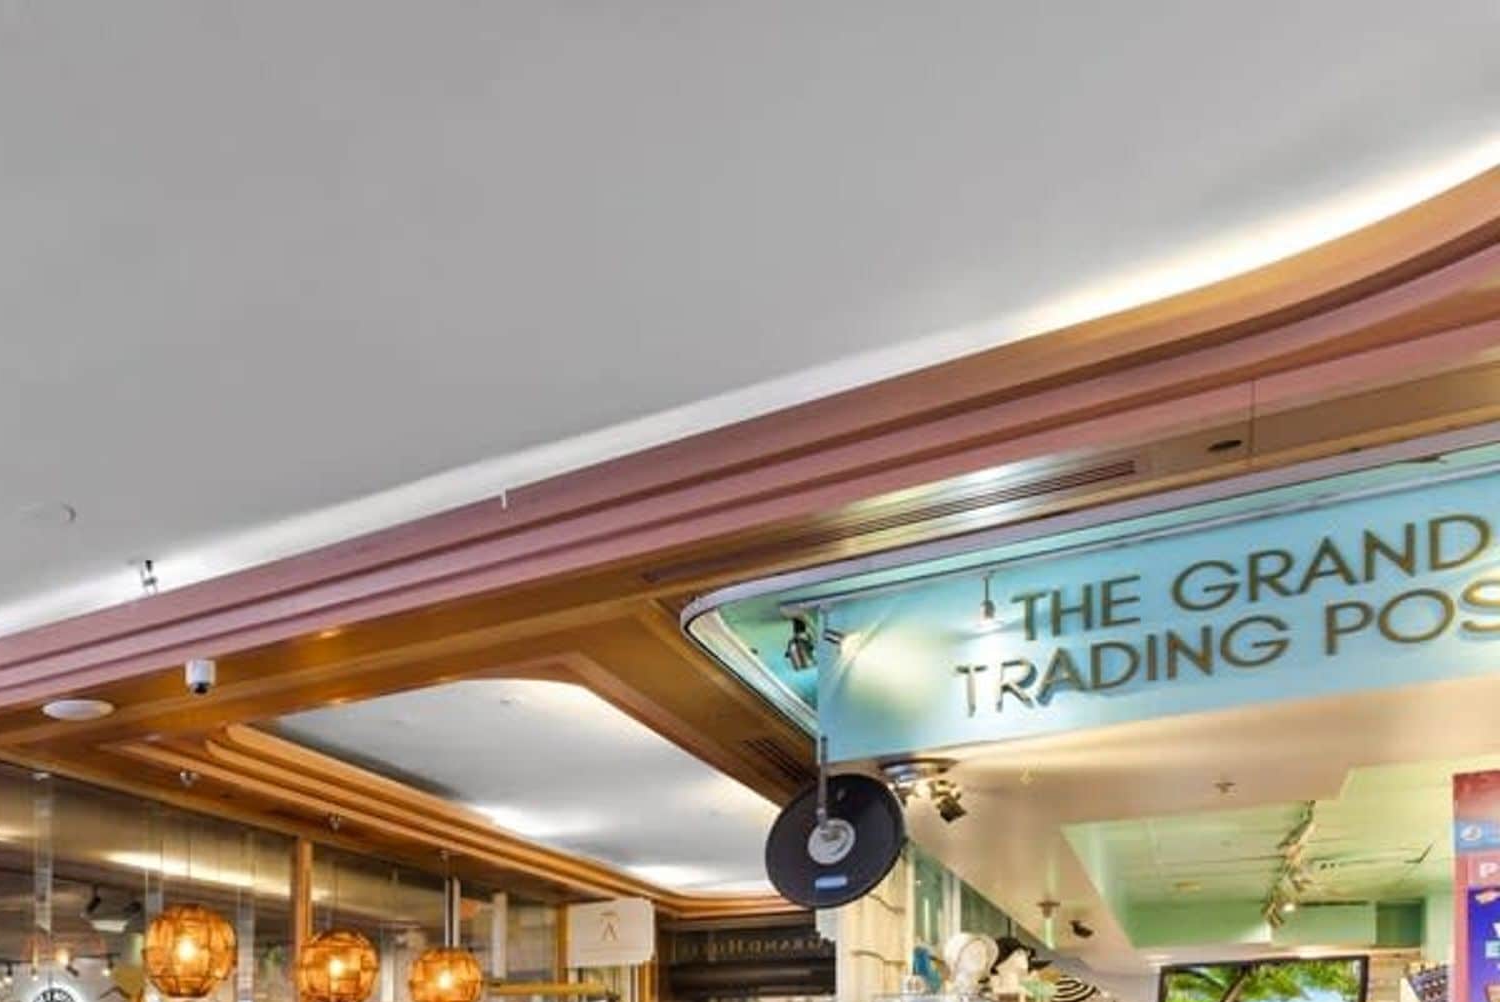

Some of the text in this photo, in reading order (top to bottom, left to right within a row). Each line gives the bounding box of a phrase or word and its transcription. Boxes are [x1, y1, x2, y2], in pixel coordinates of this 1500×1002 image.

[1011, 513, 1492, 641] THE GRAND
[954, 614, 1292, 718] TRADING
